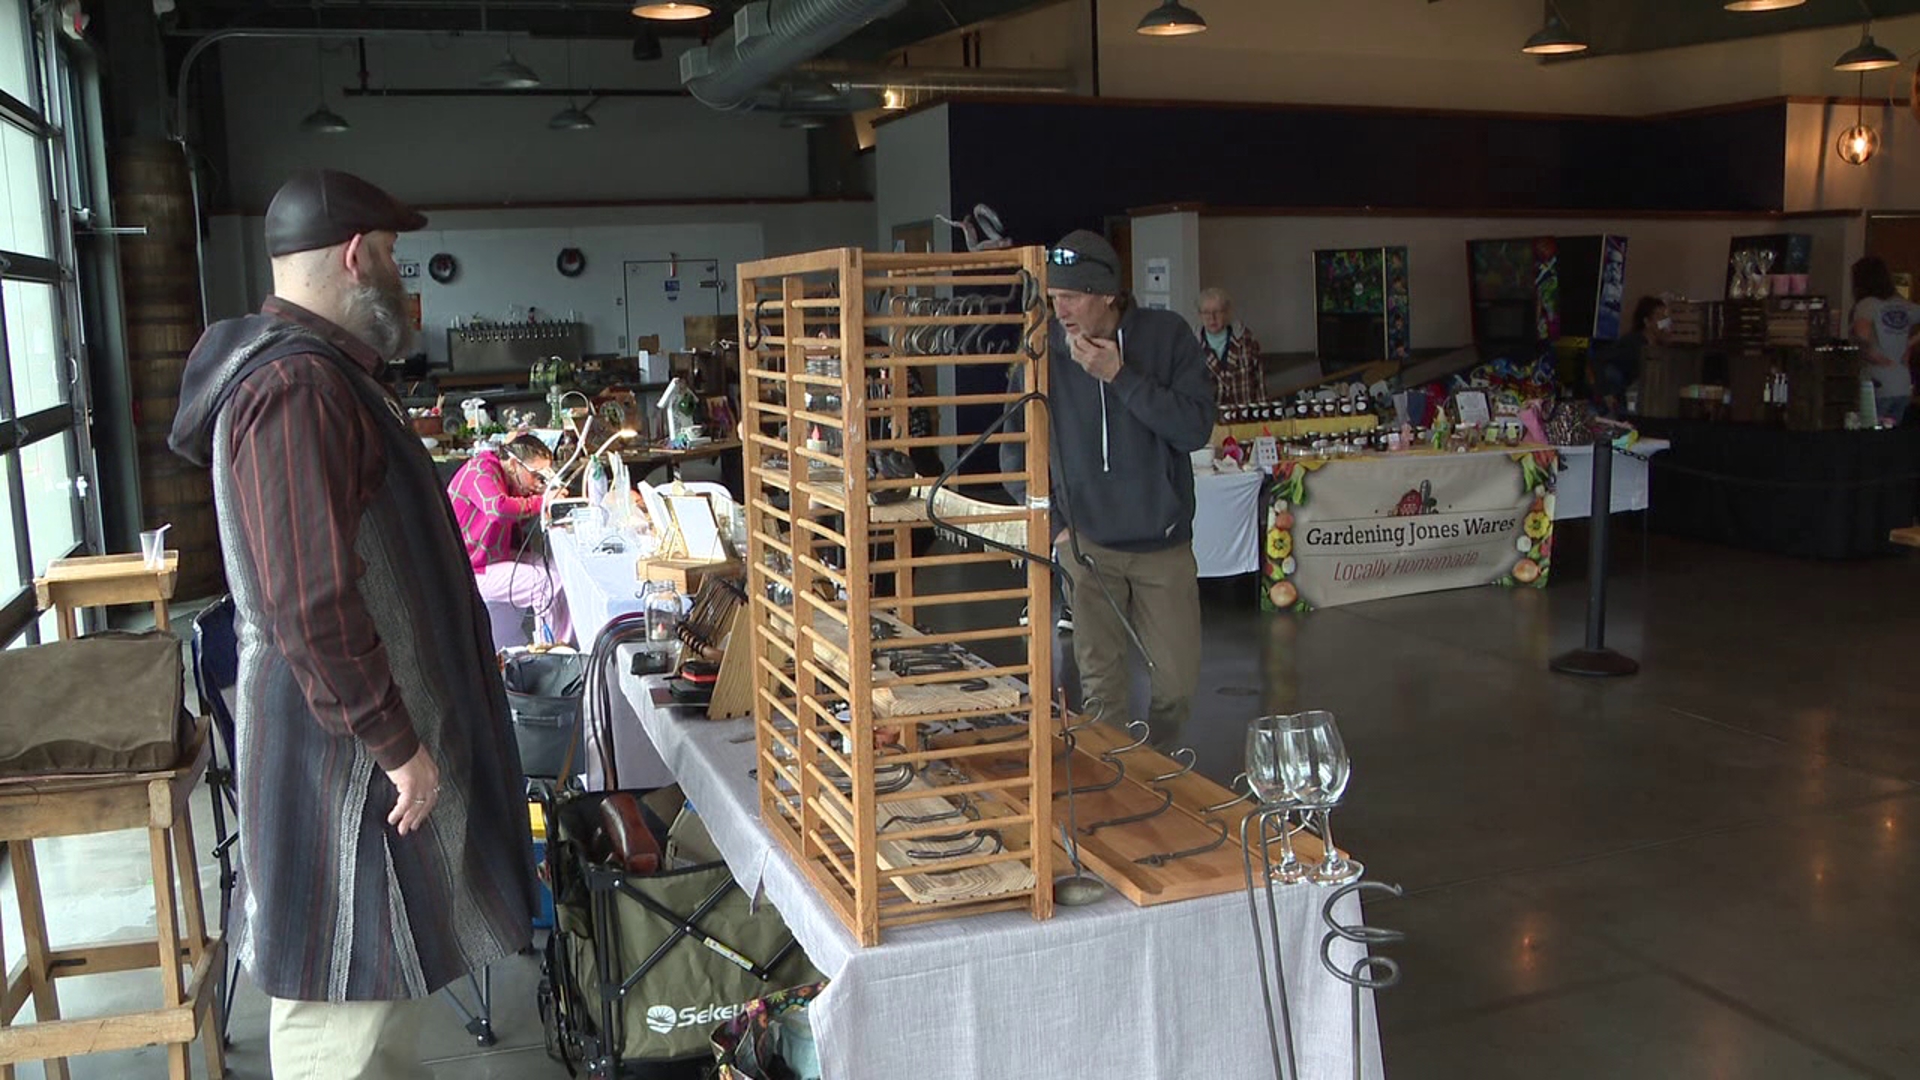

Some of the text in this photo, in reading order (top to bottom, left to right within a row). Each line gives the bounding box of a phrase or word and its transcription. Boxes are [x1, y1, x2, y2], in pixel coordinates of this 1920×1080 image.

[1306, 517, 1516, 547] Gardening Jones Wares
[1333, 551, 1479, 581] Locally Homemade
